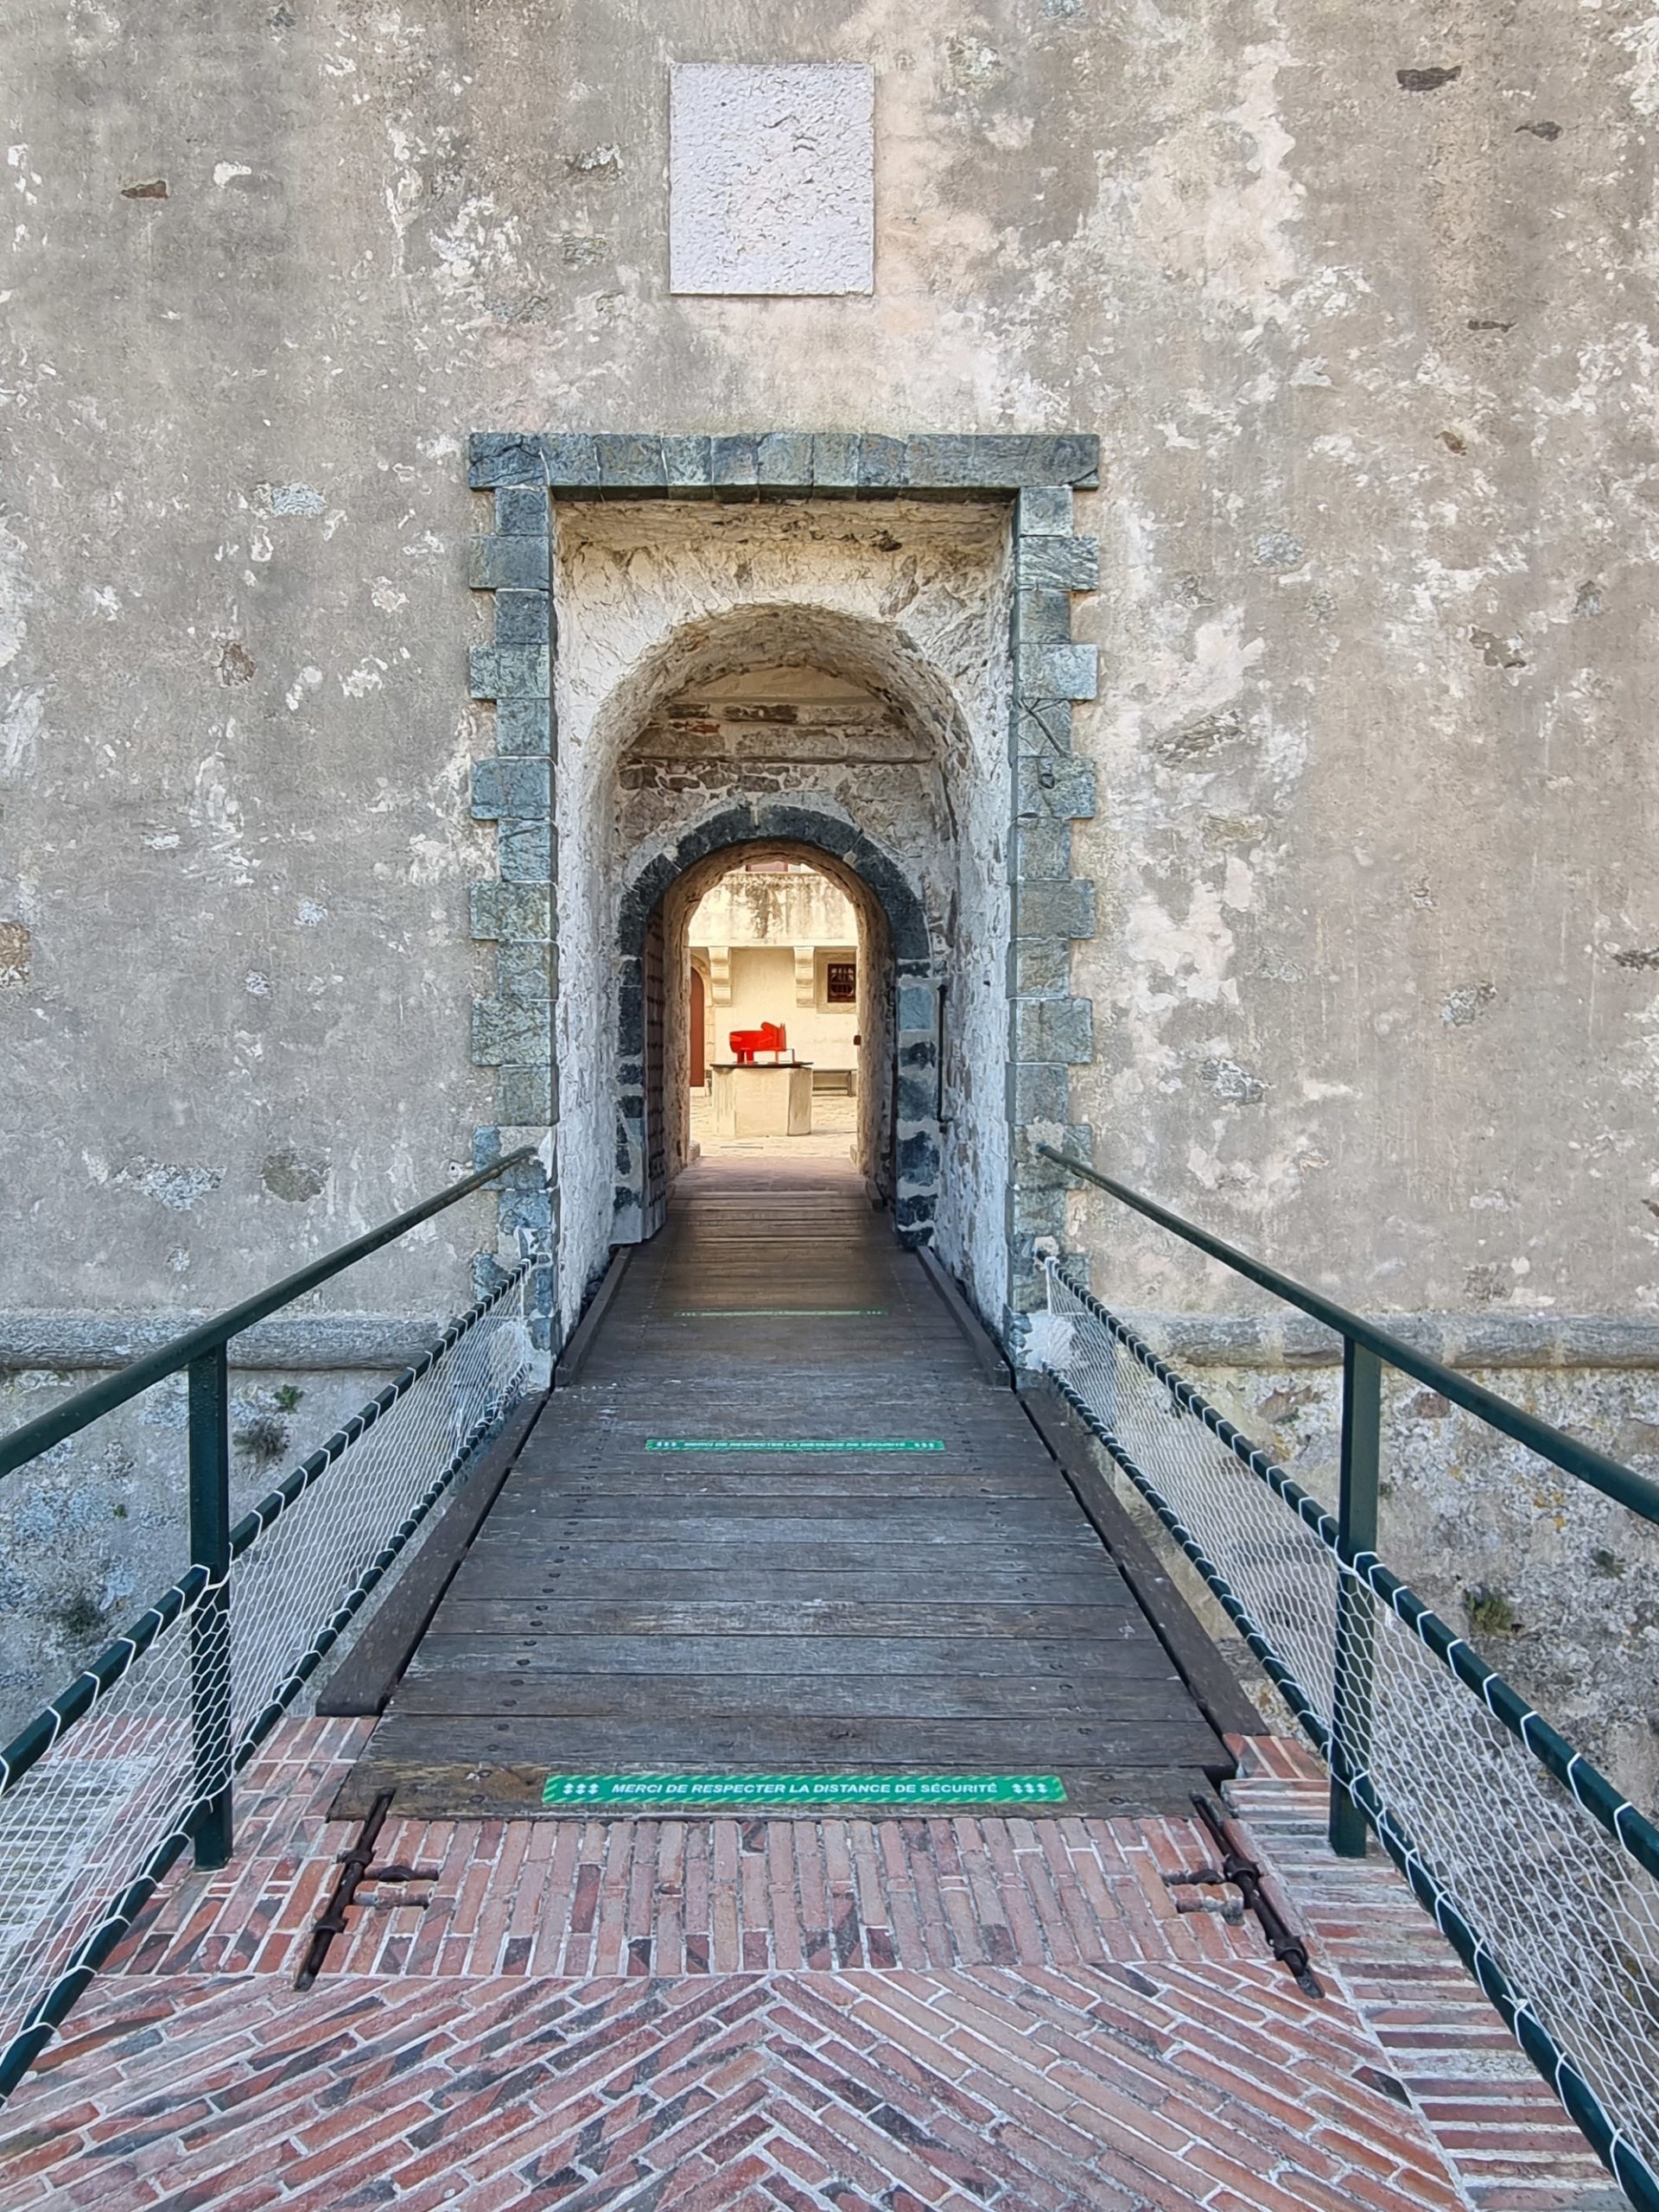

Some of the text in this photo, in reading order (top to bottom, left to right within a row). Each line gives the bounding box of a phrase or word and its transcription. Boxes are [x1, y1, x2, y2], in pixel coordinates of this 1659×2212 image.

[611, 1782, 998, 1794] MERCI DE RESPECTER LA DISTANCE DE SÉCURITÉ
